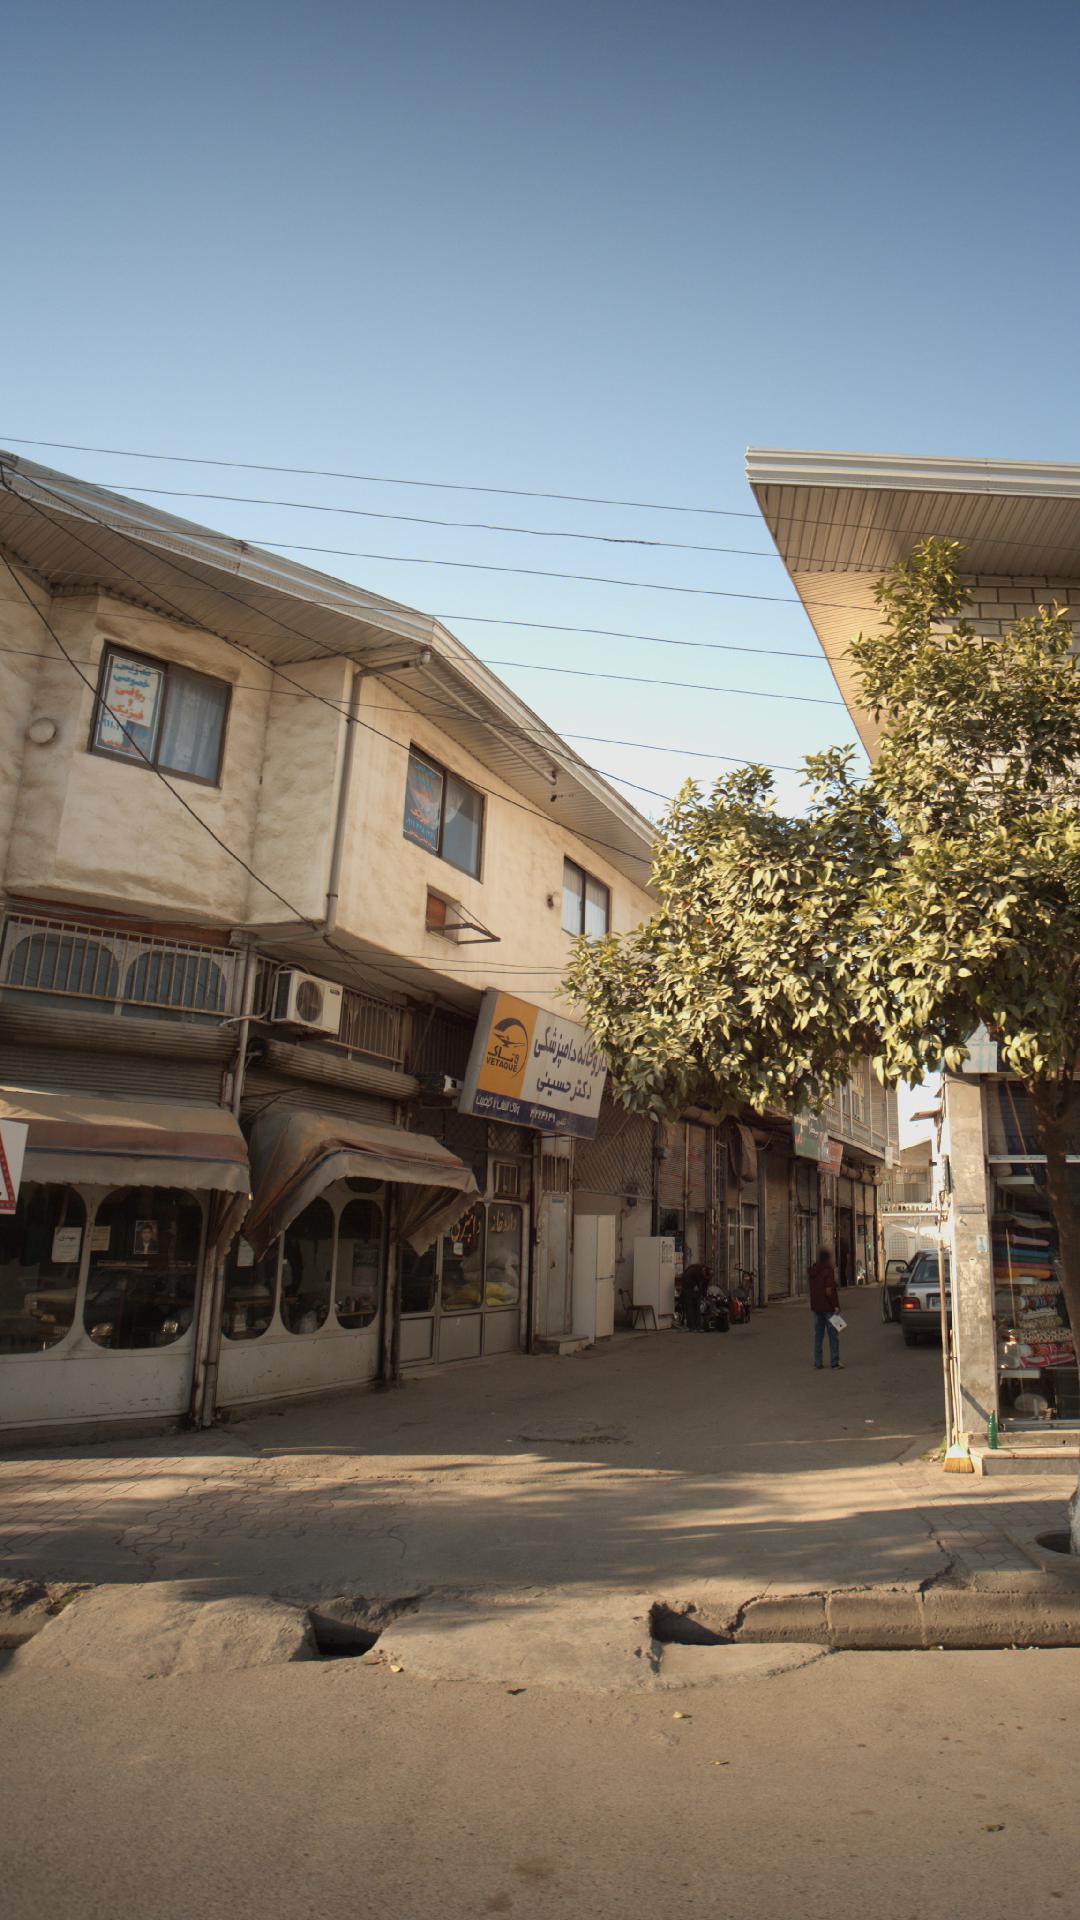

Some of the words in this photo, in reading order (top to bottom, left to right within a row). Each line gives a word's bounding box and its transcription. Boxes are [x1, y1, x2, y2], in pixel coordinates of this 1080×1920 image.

[533, 1026, 577, 1069] دامپزشکی
[486, 1056, 518, 1072] VETAQUE
[536, 1071, 572, 1097] حسینی
[569, 1079, 592, 1102] دکتر
